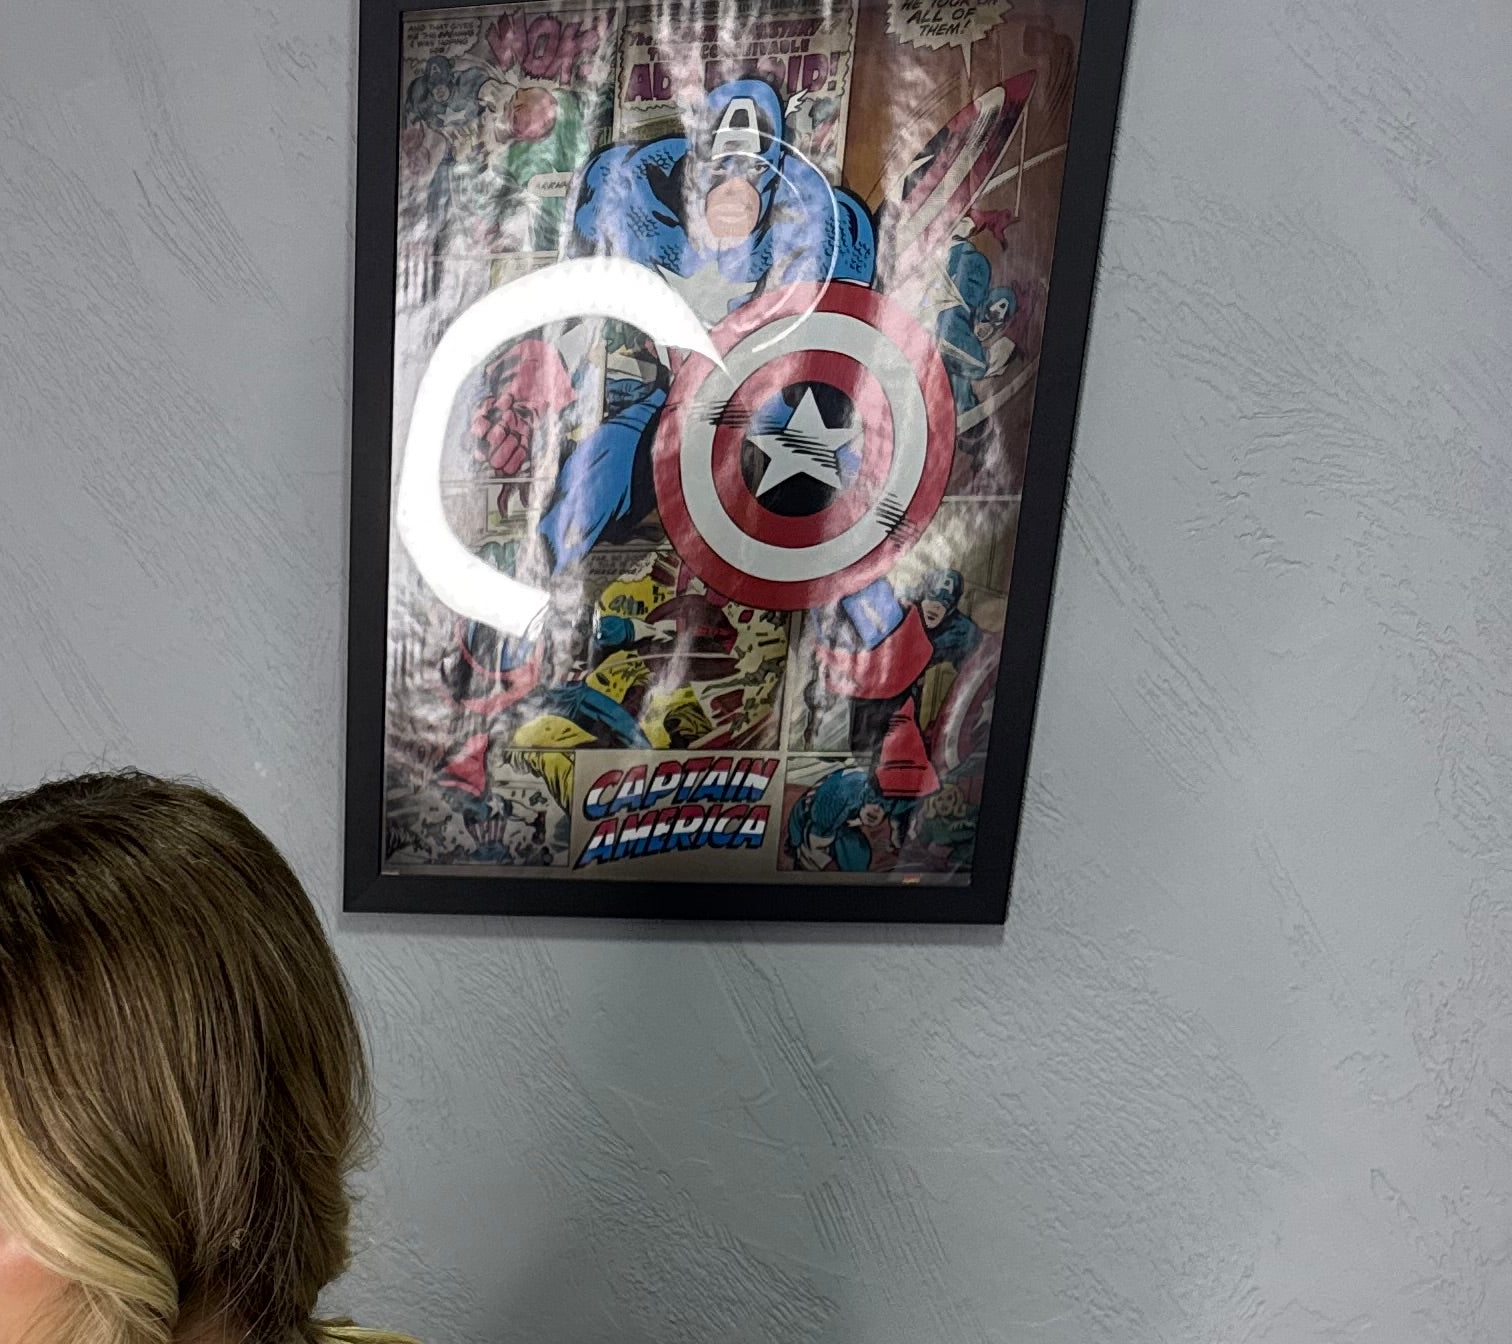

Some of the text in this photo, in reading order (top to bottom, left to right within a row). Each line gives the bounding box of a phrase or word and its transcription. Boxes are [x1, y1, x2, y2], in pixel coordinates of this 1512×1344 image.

[906, 8, 976, 24] ALL OF
[919, 20, 971, 36] THEM!
[582, 755, 780, 821] CAPTAIN
[573, 803, 771, 869] AMERICA
